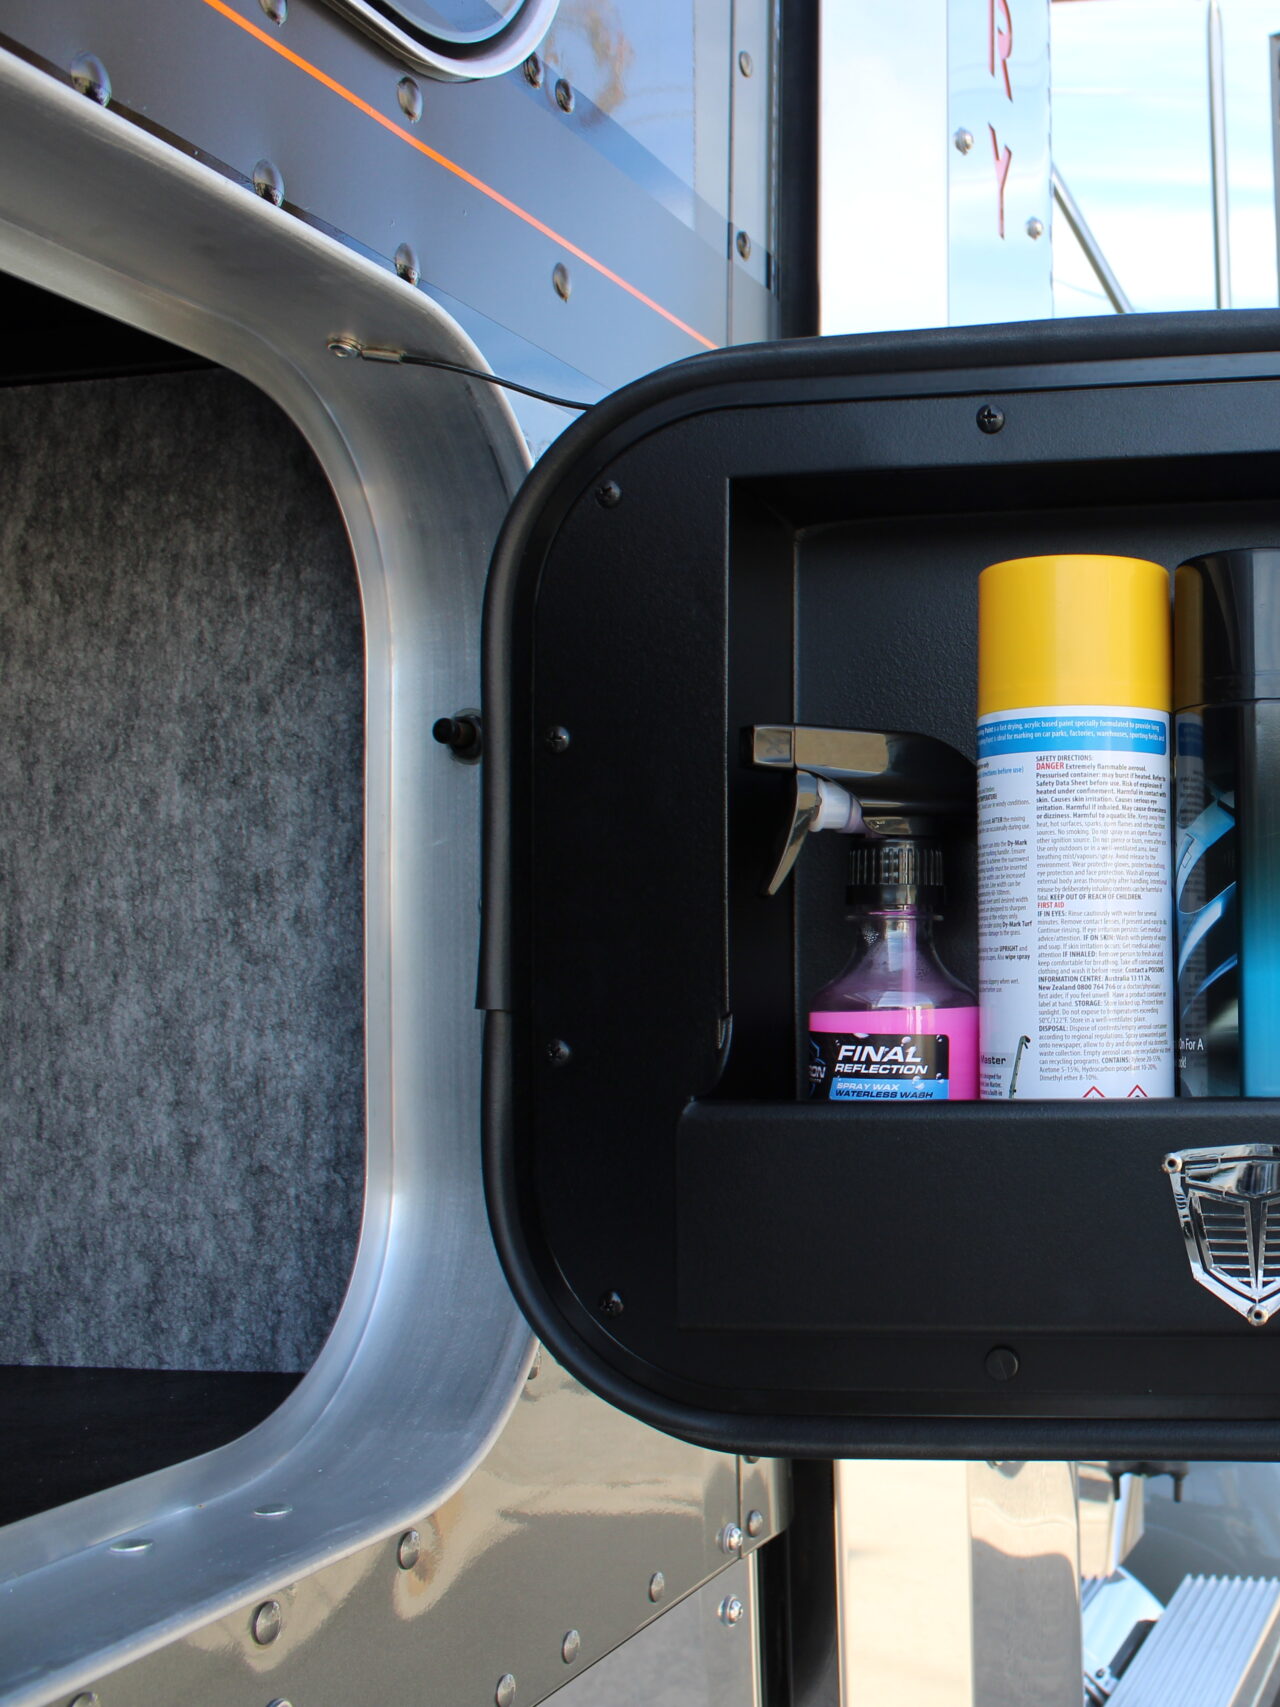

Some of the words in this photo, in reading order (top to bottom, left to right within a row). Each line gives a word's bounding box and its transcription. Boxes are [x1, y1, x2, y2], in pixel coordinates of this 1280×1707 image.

[1036, 762, 1064, 770] DANGER
[1186, 1038, 1195, 1050] For
[1197, 1038, 1203, 1050] A
[838, 1045, 923, 1062] FINAL
[835, 1063, 928, 1074] REFLECTION
[835, 1090, 897, 1099] WATERLESS
